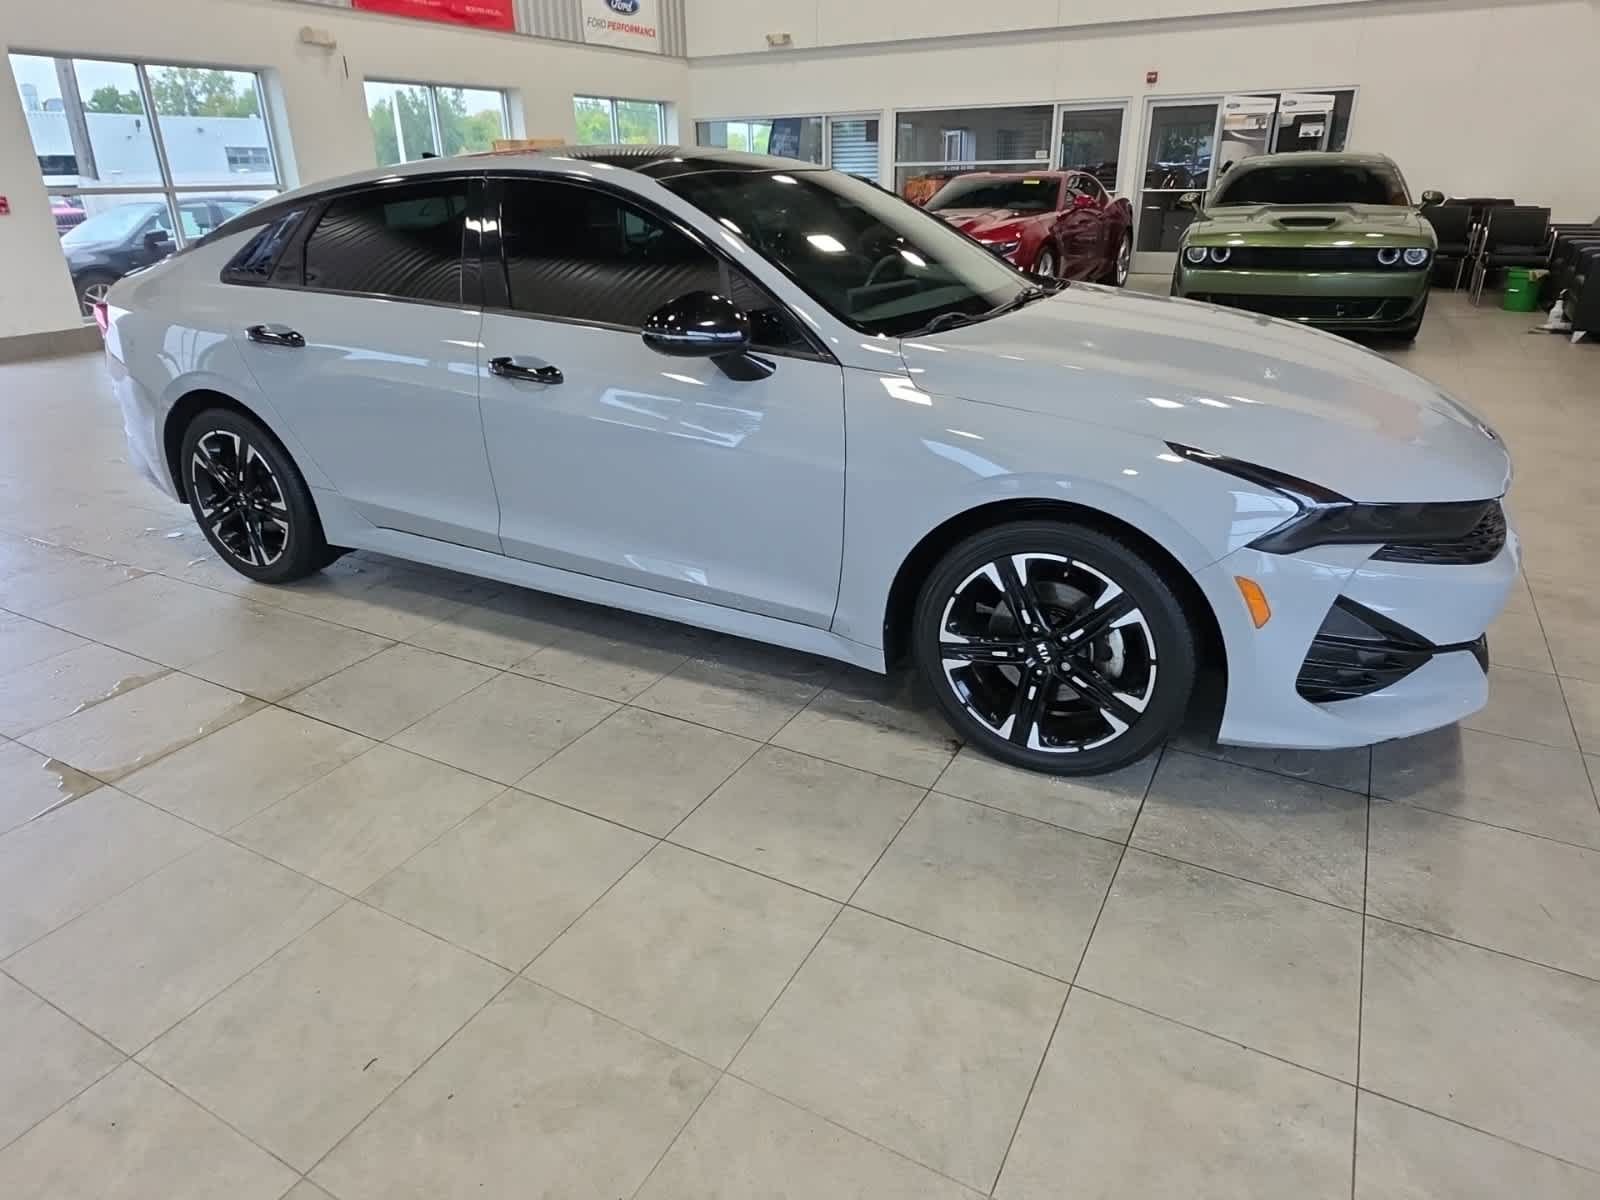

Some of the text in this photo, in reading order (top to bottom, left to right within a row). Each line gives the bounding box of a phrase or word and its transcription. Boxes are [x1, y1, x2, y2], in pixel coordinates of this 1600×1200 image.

[587, 16, 656, 38] FORD PERFORMANCE
[1036, 643, 1051, 663] KIA
